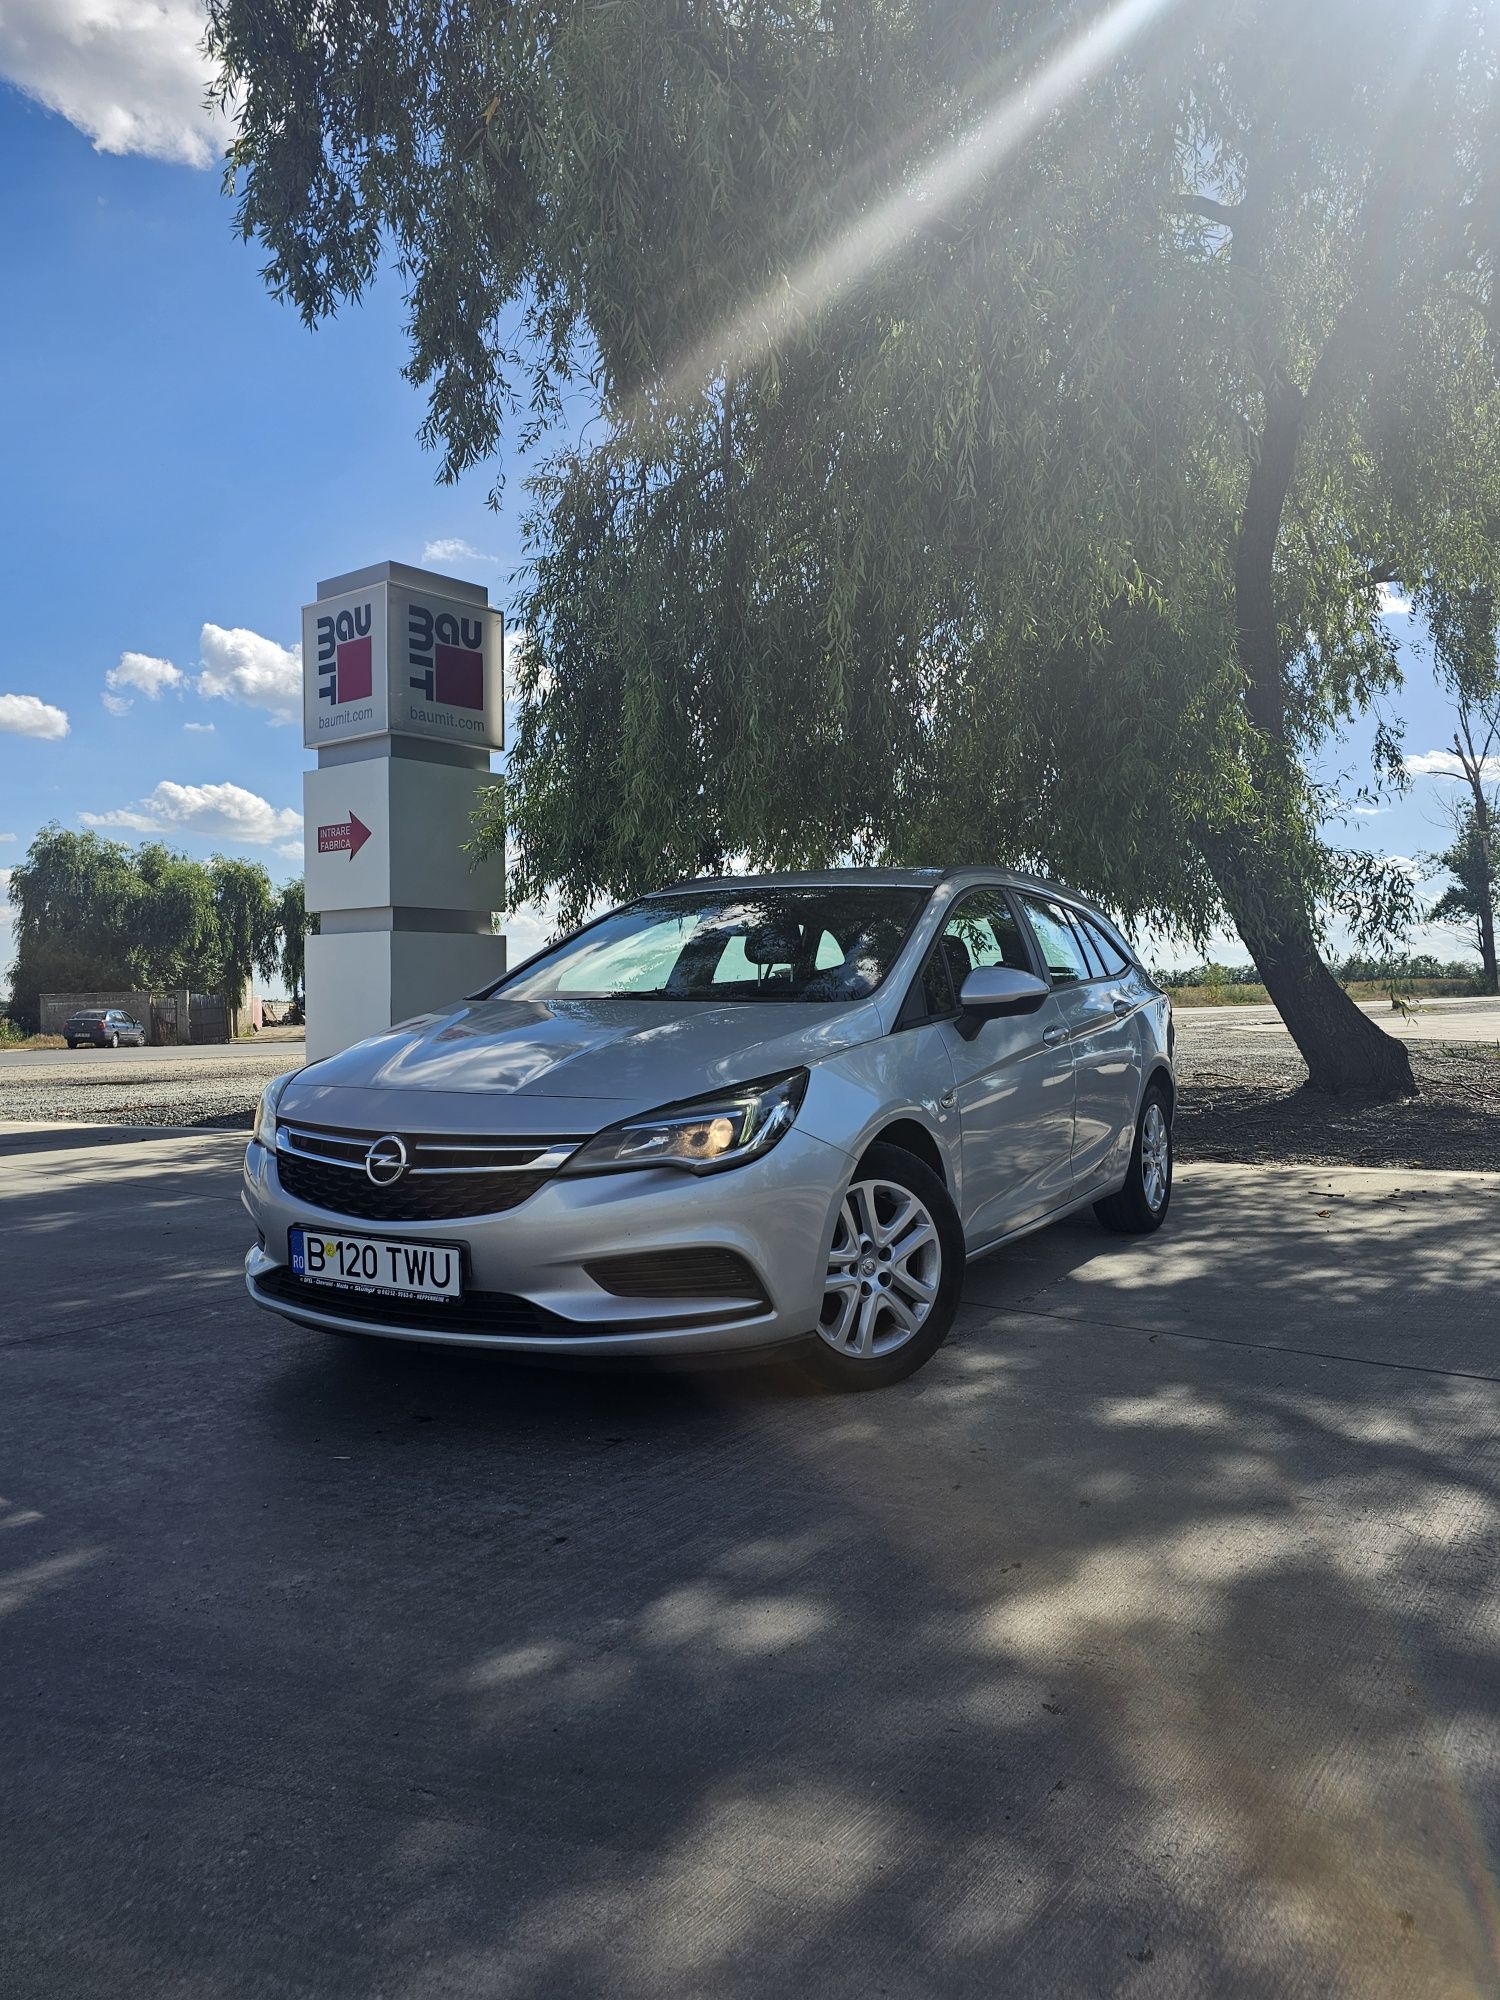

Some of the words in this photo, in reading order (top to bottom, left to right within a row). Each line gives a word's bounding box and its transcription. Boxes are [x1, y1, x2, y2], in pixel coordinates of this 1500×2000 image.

[318, 708, 373, 729] baumit.com
[410, 706, 485, 732] baumit.com
[320, 825, 351, 838] INTRARE
[320, 839, 351, 851] FABRICA
[293, 1255, 304, 1269] RO
[307, 1237, 326, 1272] B
[335, 1241, 377, 1279] 120
[386, 1246, 450, 1288] TWU
